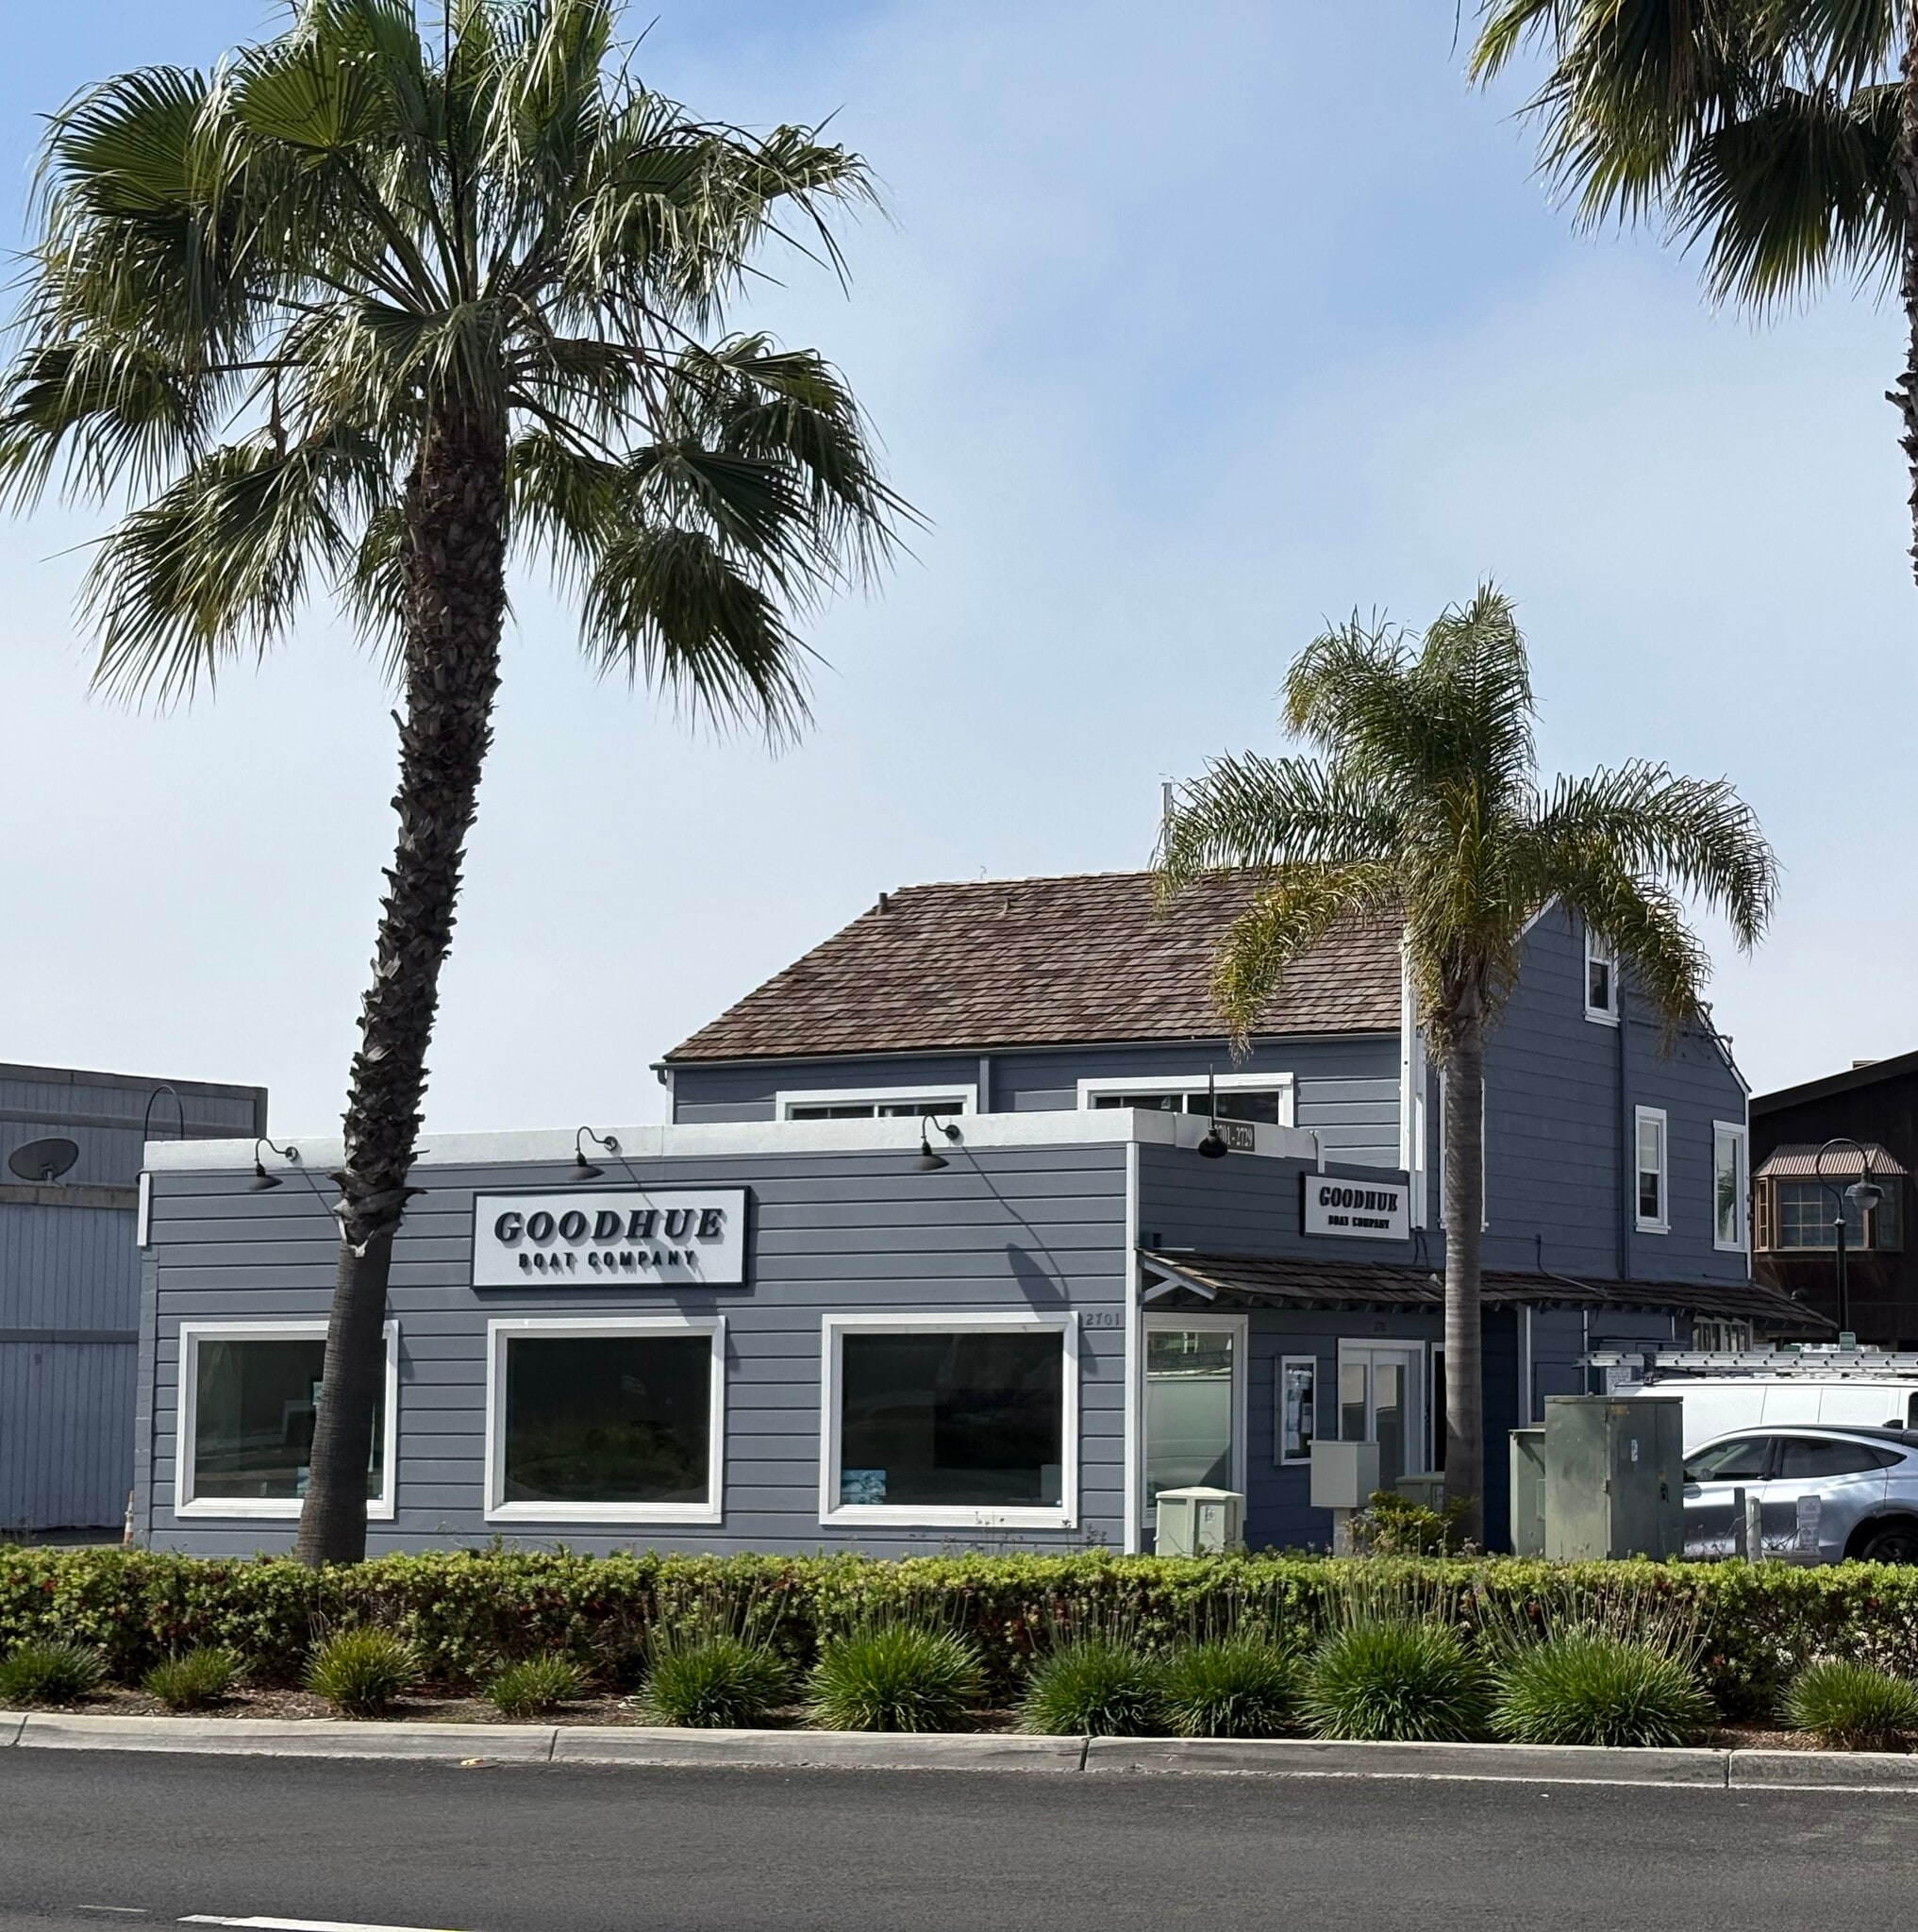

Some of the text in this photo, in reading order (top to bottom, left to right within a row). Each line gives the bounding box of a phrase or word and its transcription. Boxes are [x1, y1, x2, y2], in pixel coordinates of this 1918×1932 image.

[1319, 1186, 1398, 1212] GOODHUE
[493, 1208, 725, 1241] GOODHUE
[519, 1250, 695, 1268] BOAT COMPANY
[1086, 1312, 1120, 1326] 2701
